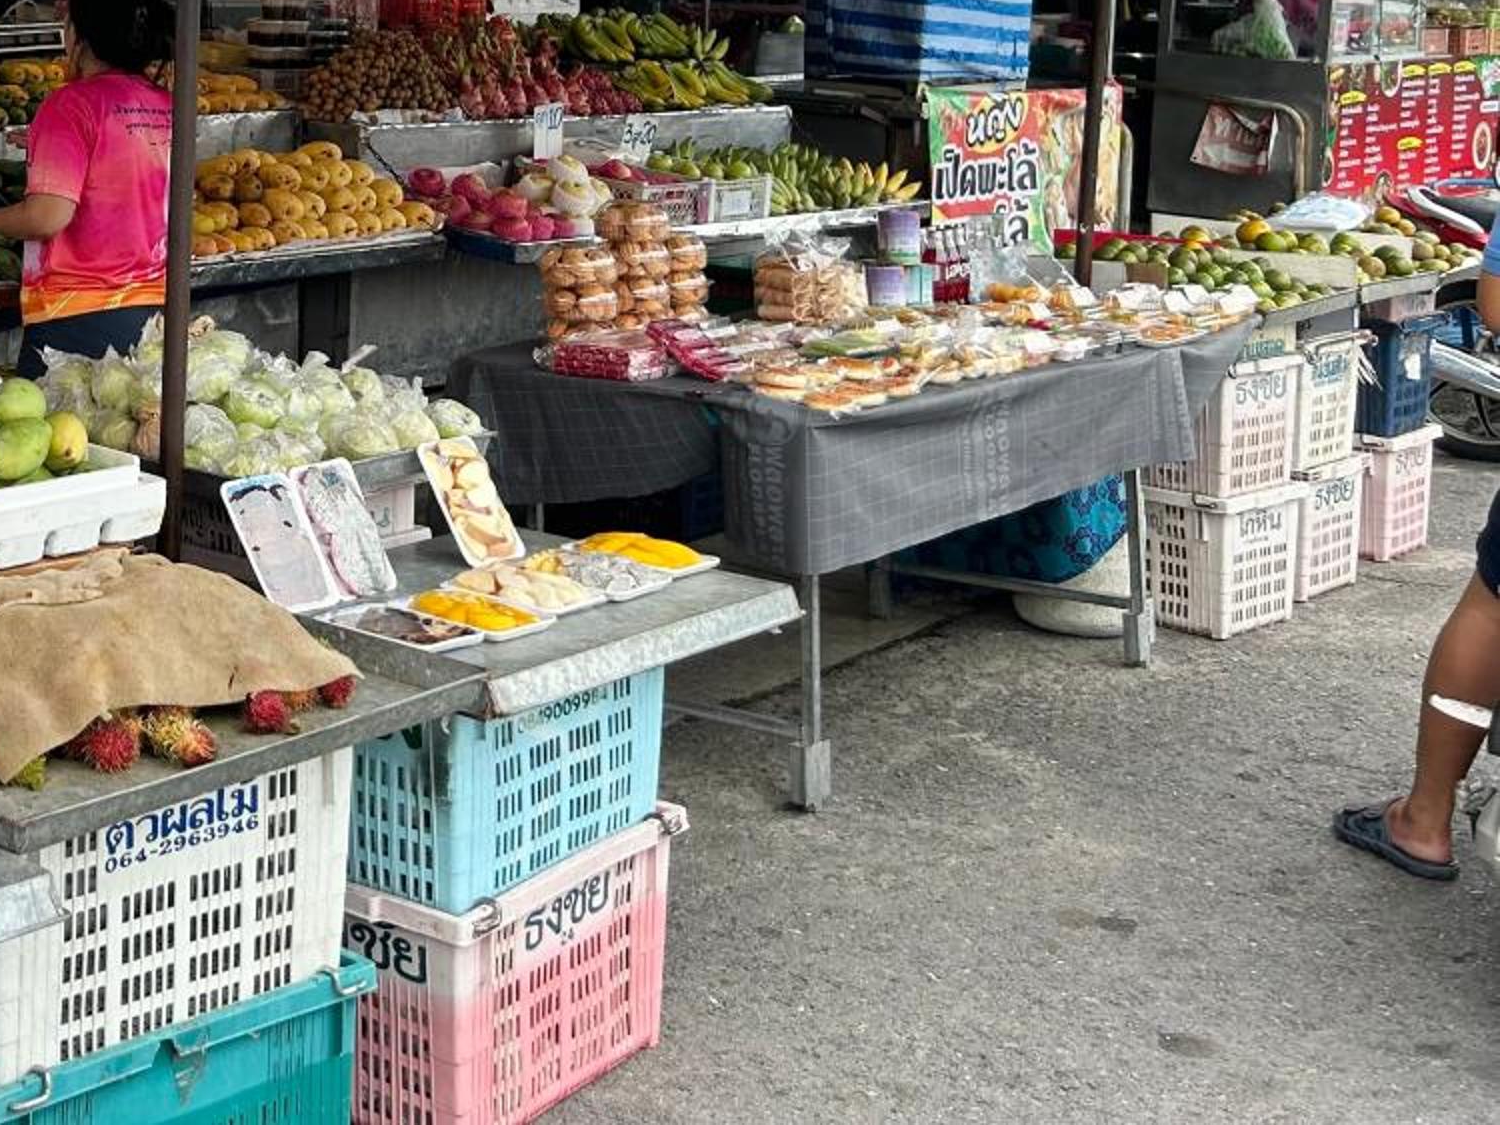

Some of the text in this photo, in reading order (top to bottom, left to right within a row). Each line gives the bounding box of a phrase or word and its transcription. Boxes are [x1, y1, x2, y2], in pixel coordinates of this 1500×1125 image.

[934, 143, 1038, 201] เป็ดพะโล้
[104, 813, 259, 874] 064-2963946
[524, 869, 610, 951] ธงชย
